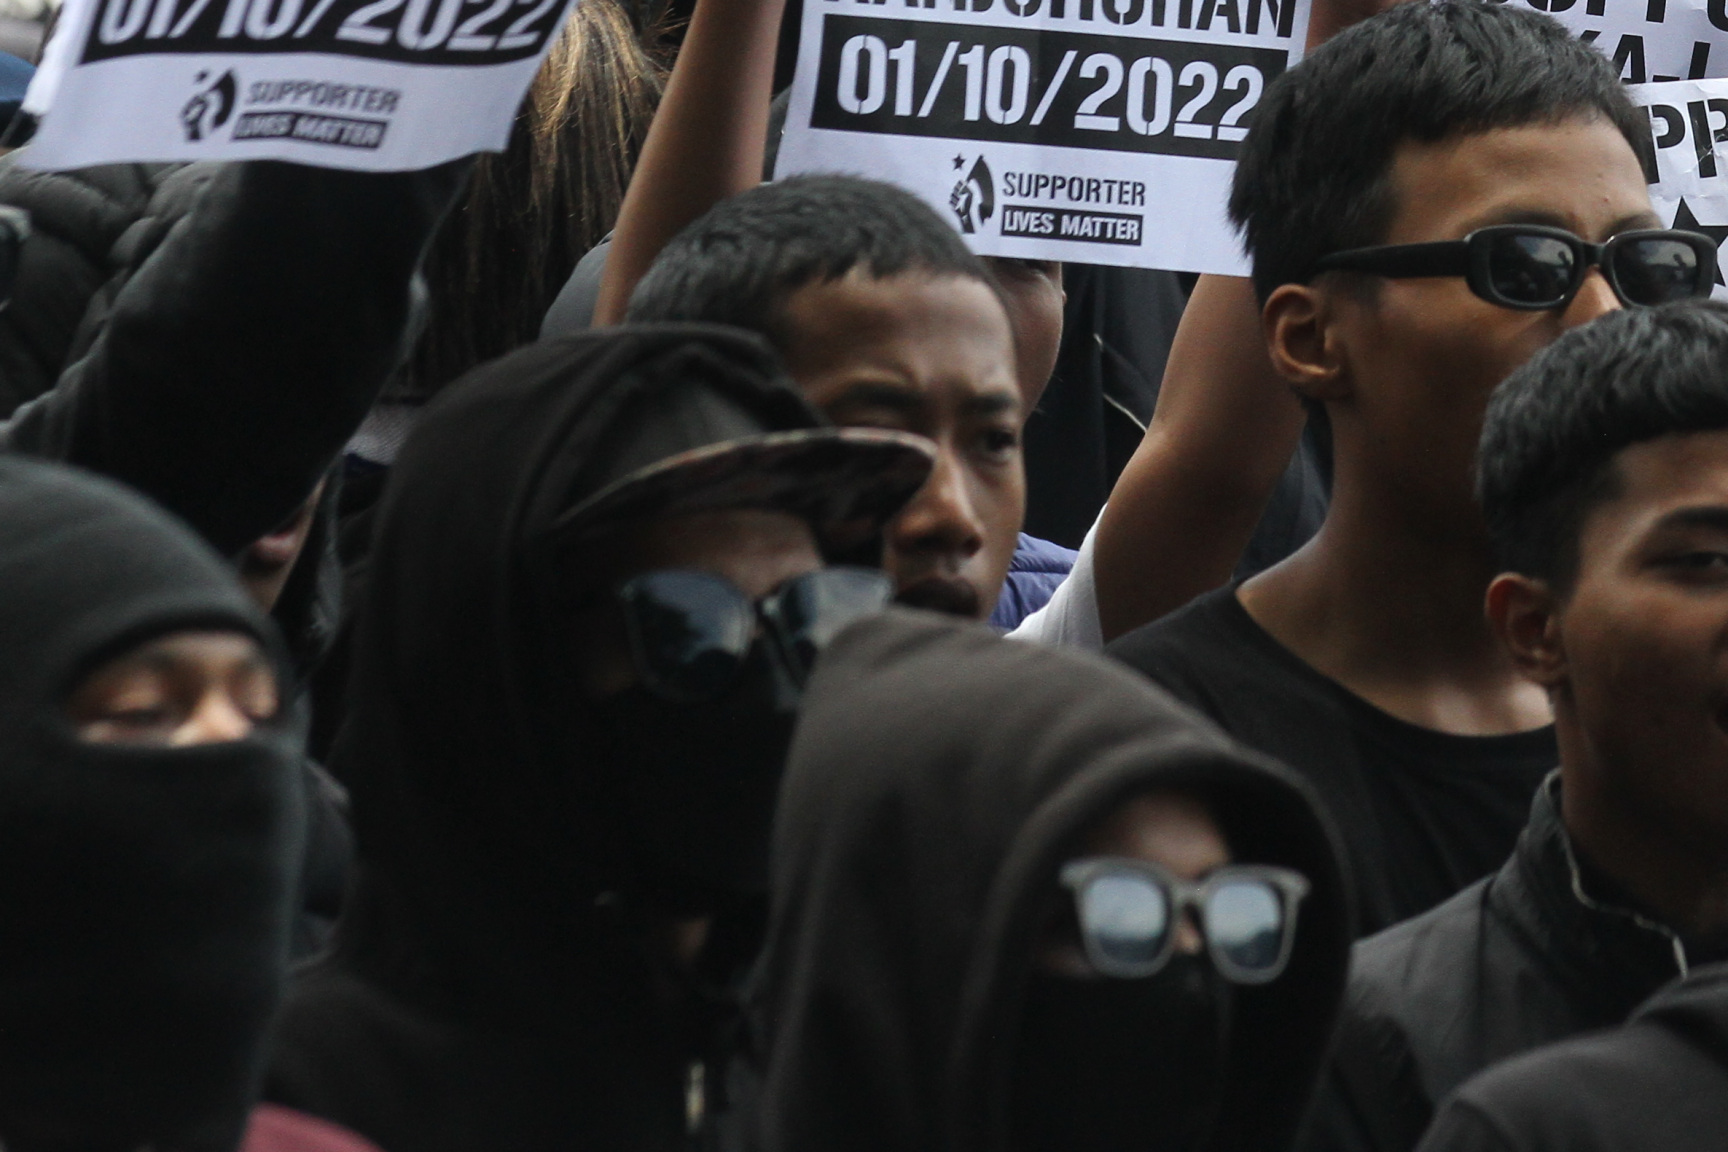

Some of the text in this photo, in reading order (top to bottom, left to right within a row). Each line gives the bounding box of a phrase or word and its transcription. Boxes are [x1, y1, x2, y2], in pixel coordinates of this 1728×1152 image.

[247, 80, 402, 113] SUPPORTER
[836, 35, 1264, 142] 01/10/2022
[293, 117, 383, 145] MATTER
[1003, 171, 1146, 207] SUPPORTER
[1003, 209, 1139, 240] LIVES MATTER
